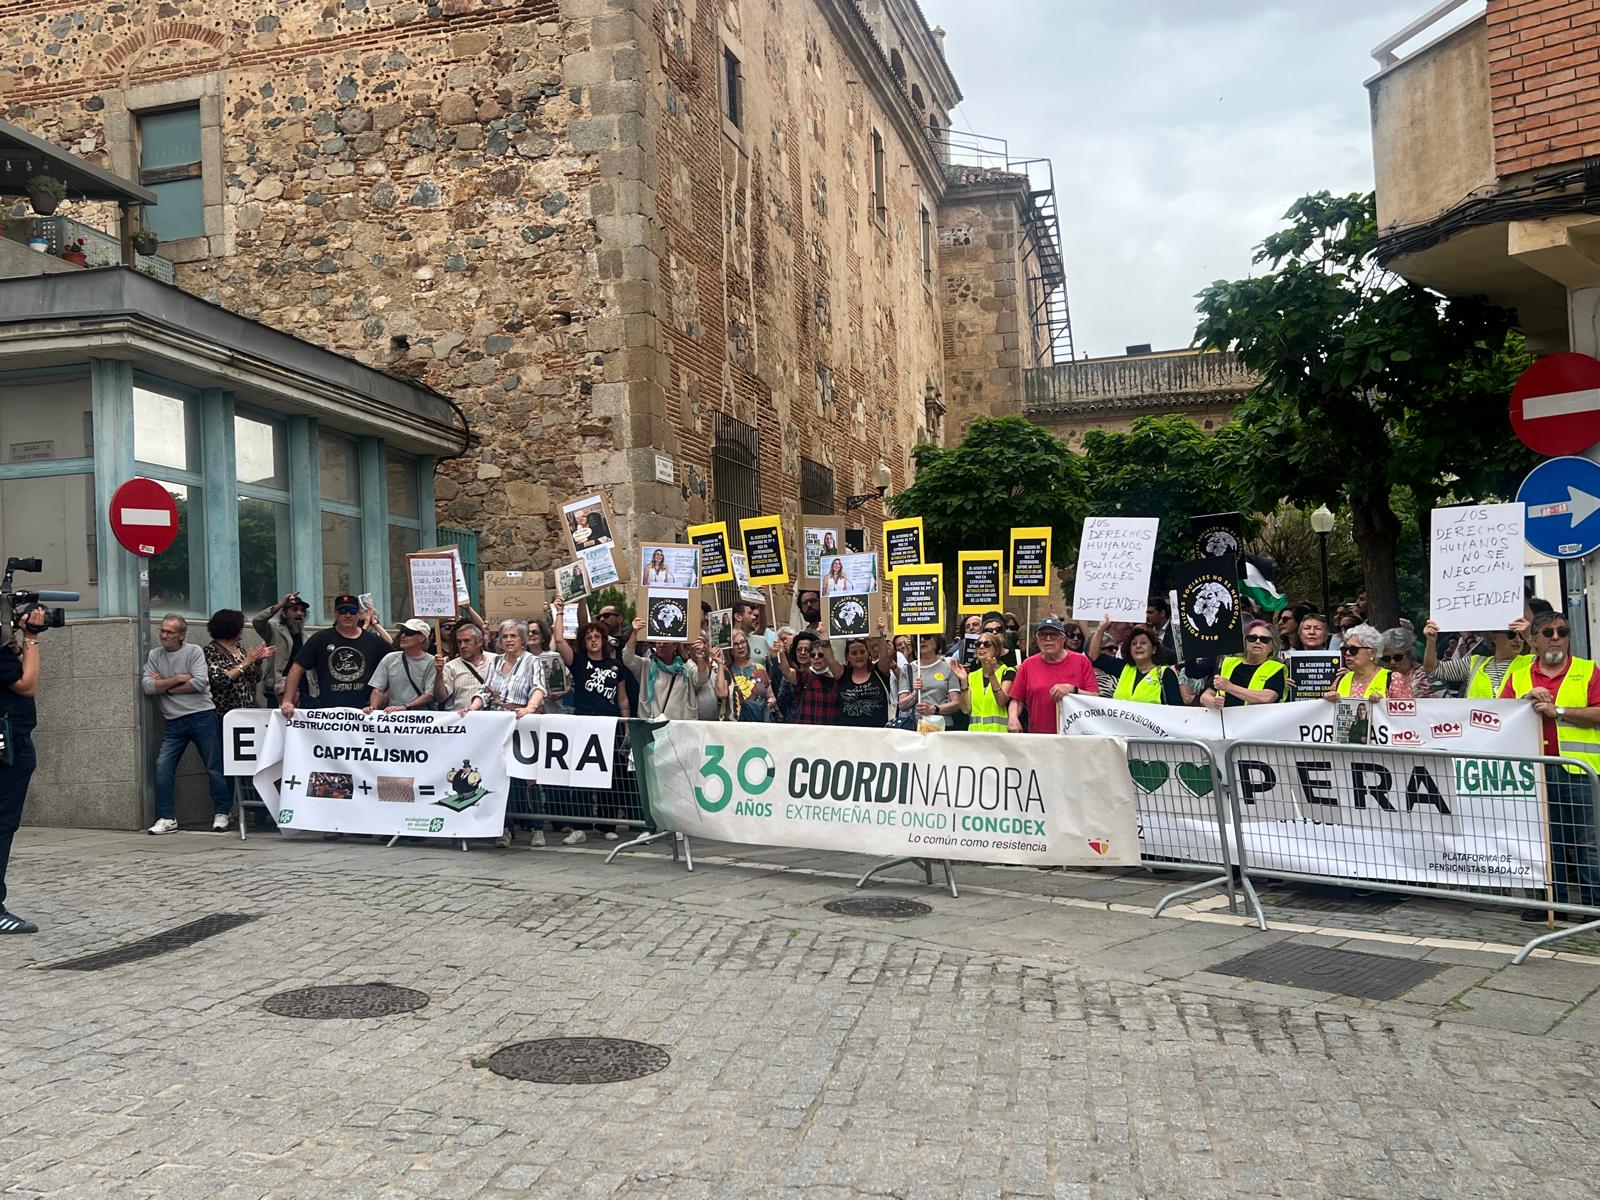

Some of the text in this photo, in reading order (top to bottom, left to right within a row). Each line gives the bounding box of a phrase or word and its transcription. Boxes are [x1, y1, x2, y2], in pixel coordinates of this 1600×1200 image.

[1455, 510, 1488, 523] LOS
[1088, 519, 1110, 528] LOS
[1089, 530, 1152, 540] DERECHOS
[1436, 523, 1519, 540] DERECHOS
[1087, 541, 1142, 550] HUMANOS
[1440, 537, 1508, 552] HUMANOS
[1112, 551, 1135, 559] LAS
[1462, 550, 1504, 563] NO SE
[1085, 571, 1134, 581] SOCIALES
[1456, 581, 1476, 591] SE
[504, 596, 527, 606] ES
[1184, 574, 1210, 598] SOCIALES
[1224, 580, 1232, 589] SE
[1228, 587, 1239, 630] NEGOCIAN
[1389, 702, 1414, 711] NO+
[307, 711, 365, 721] GENOCIDIO
[377, 715, 434, 723] FASCISMO
[1063, 709, 1106, 735] PLATAFORMA
[1107, 709, 1118, 718] DE
[1473, 712, 1499, 724] NO+
[286, 719, 359, 732] DESTRUCCIÓN
[394, 726, 466, 734] NATURALEZA
[1433, 723, 1460, 733] NO+
[313, 745, 429, 763] CAPITALISMO
[695, 744, 775, 813] 30
[788, 757, 1046, 814] COORDINADORA
[735, 798, 773, 817] AÑOS
[786, 804, 1046, 836] EXTREMEÑA DE ONGD CONGDEX
[908, 833, 1047, 852] Lo común como resistencia
[1442, 853, 1497, 862] PLATAFORMA
[1429, 863, 1530, 875] PENSIONISTAS BADAJOZ
